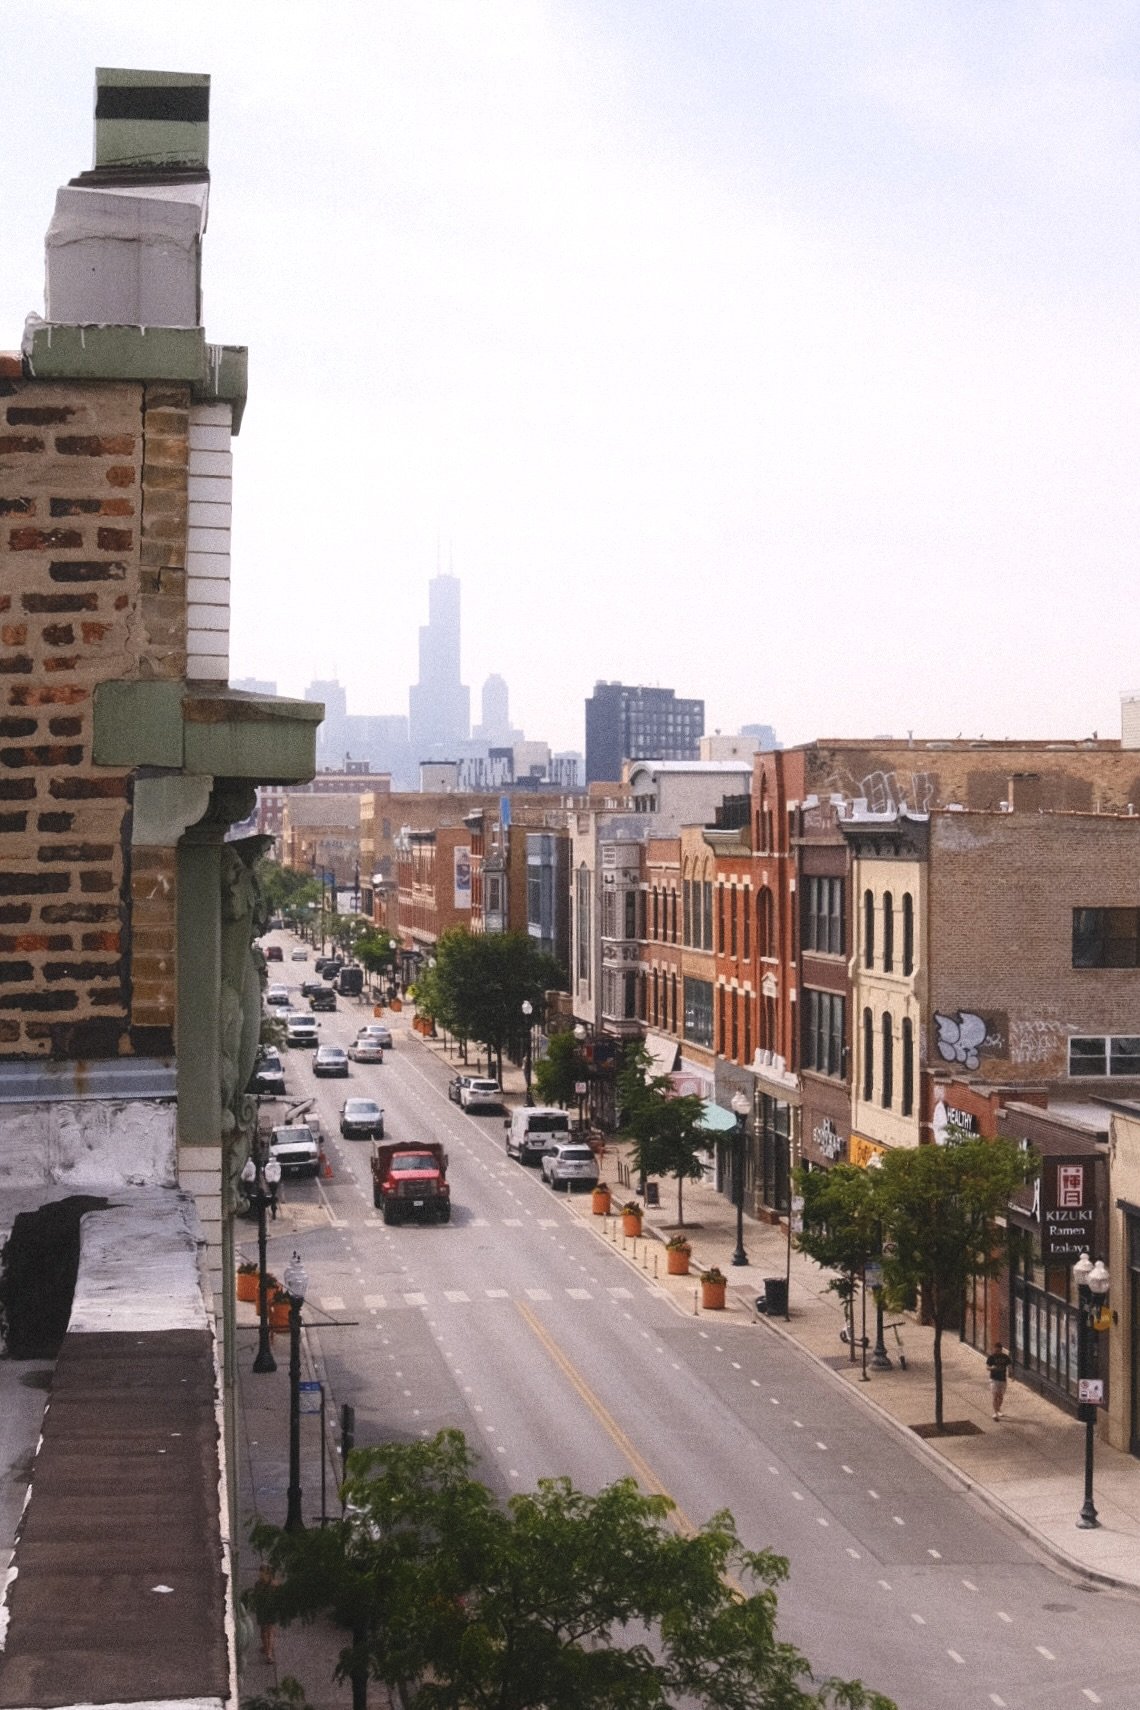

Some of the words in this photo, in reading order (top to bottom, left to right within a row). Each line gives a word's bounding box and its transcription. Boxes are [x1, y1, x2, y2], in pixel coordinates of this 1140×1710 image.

[947, 1106, 973, 1131] HEALTHY
[1045, 1209, 1094, 1222] KIZUKI
[1049, 1225, 1086, 1236] Ramen
[1050, 1242, 1091, 1253] Izakaya
